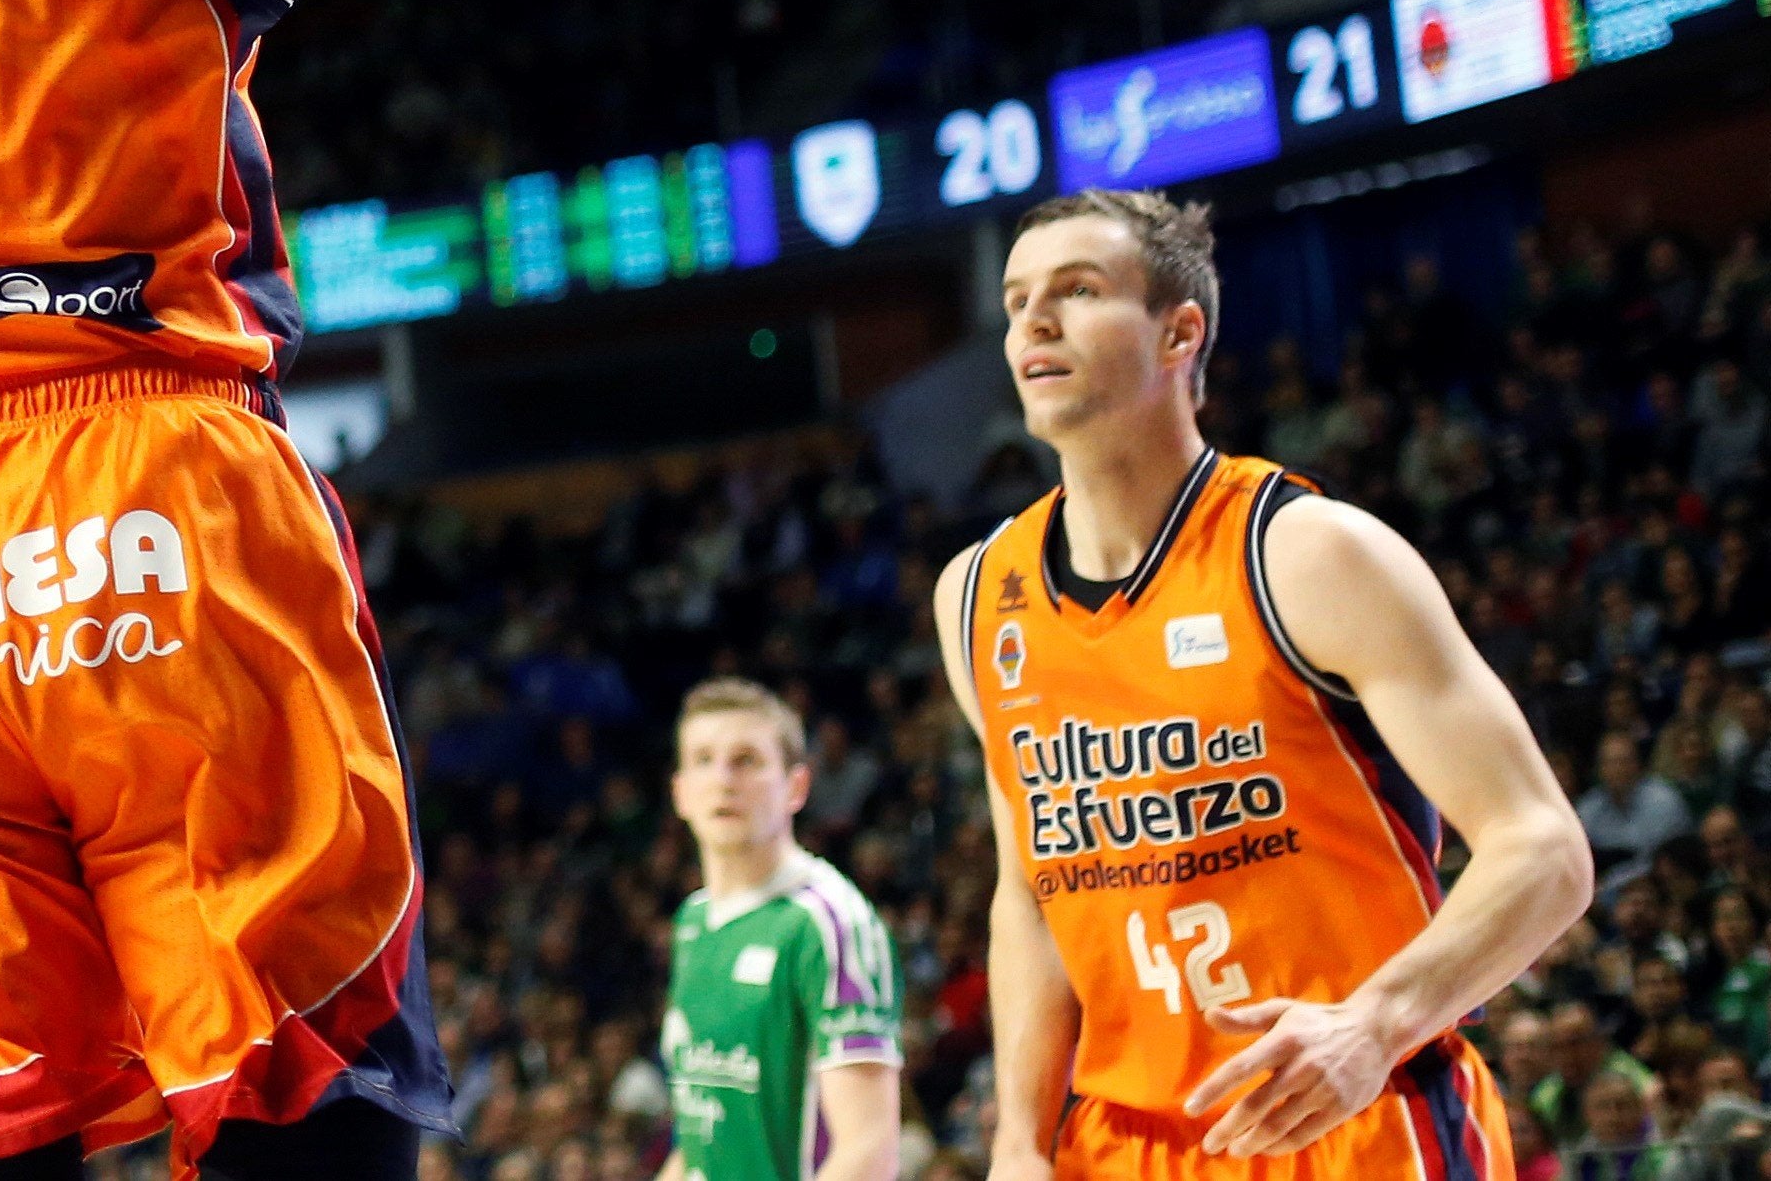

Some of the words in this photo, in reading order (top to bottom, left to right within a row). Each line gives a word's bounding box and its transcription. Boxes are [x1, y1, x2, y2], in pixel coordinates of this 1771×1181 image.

[1287, 14, 1378, 125] 21
[935, 99, 1042, 207] 20
[1010, 715, 1199, 787] Cultura
[1204, 720, 1266, 767] del
[1026, 773, 1285, 860] Esfuerzo
[1034, 826, 1302, 904] @ValenciaBasket
[1126, 899, 1252, 1015] 42
